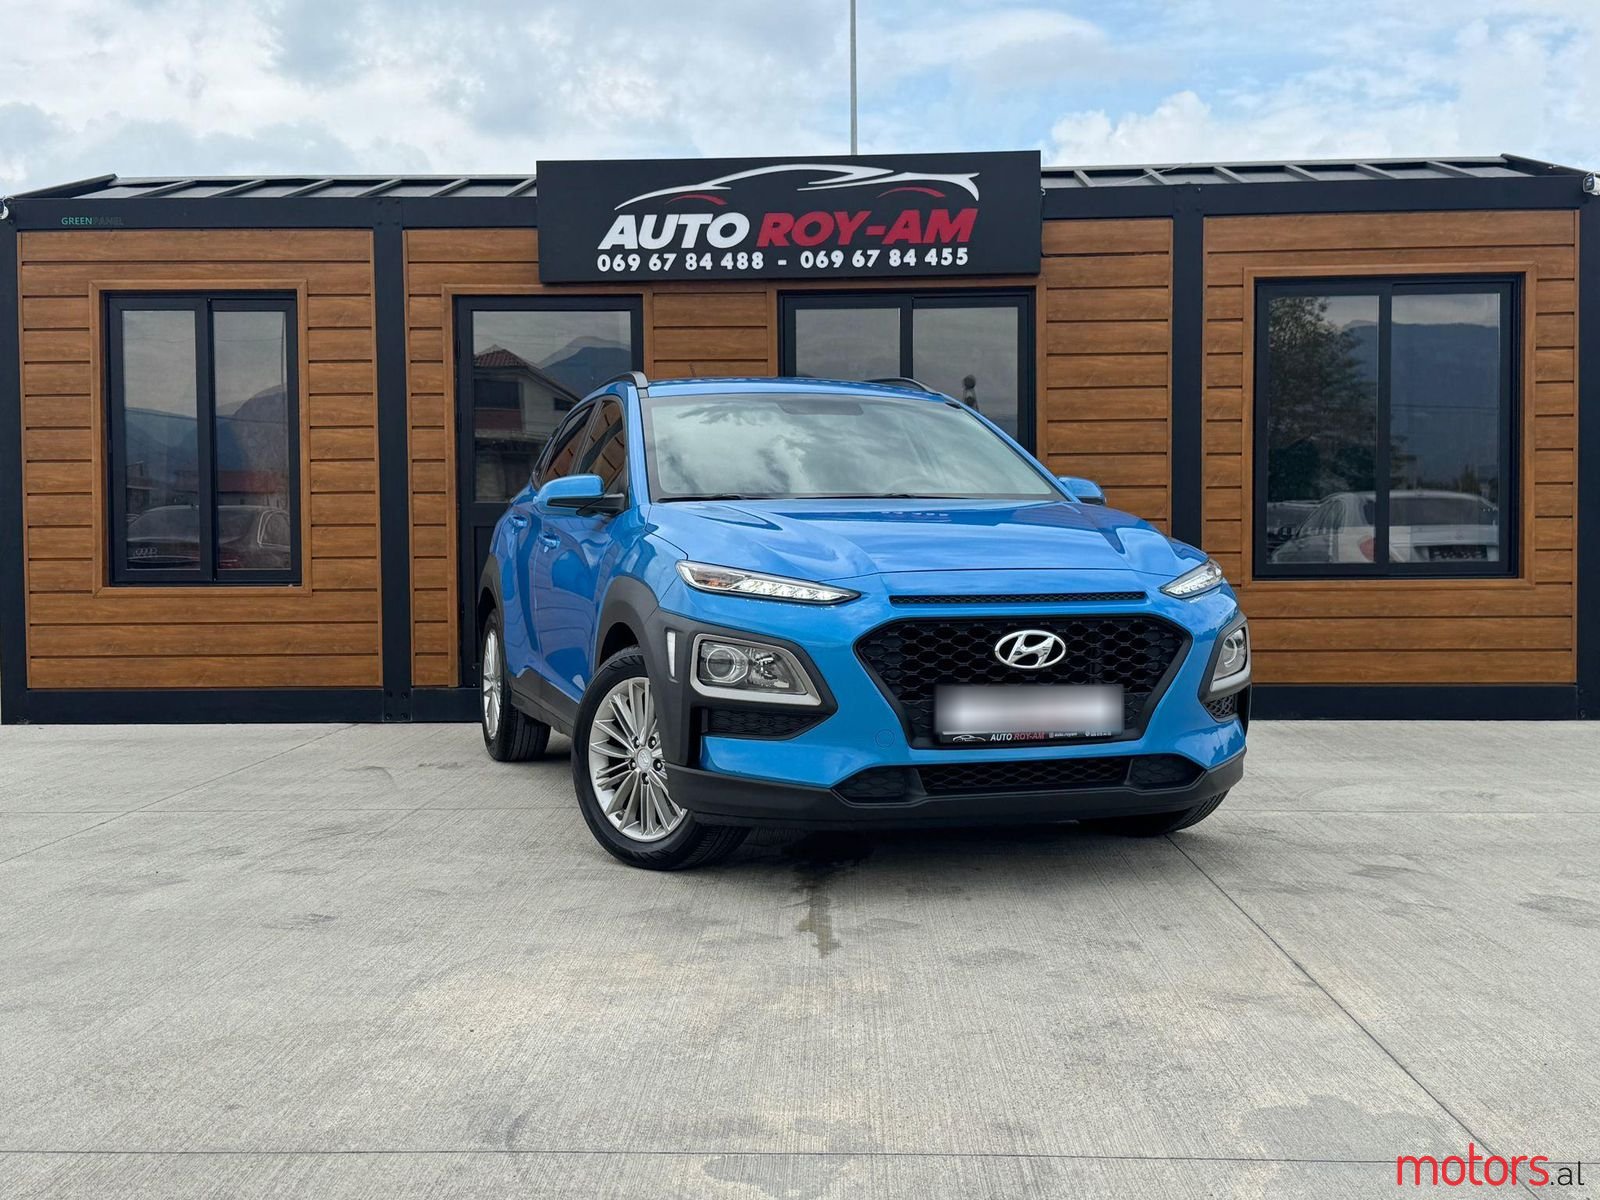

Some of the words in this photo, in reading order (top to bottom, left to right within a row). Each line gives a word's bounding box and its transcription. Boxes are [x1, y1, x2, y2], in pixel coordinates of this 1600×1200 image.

[597, 212, 750, 250] AUTO
[757, 208, 977, 247] ROY-AM
[597, 254, 641, 272] 069
[648, 253, 677, 271] 67
[685, 252, 713, 270] 84
[720, 251, 764, 270] 488
[800, 250, 844, 268] 069
[852, 249, 881, 267] 67
[888, 248, 917, 266] 84
[924, 247, 969, 265] 455
[990, 733, 1012, 742] AUTO
